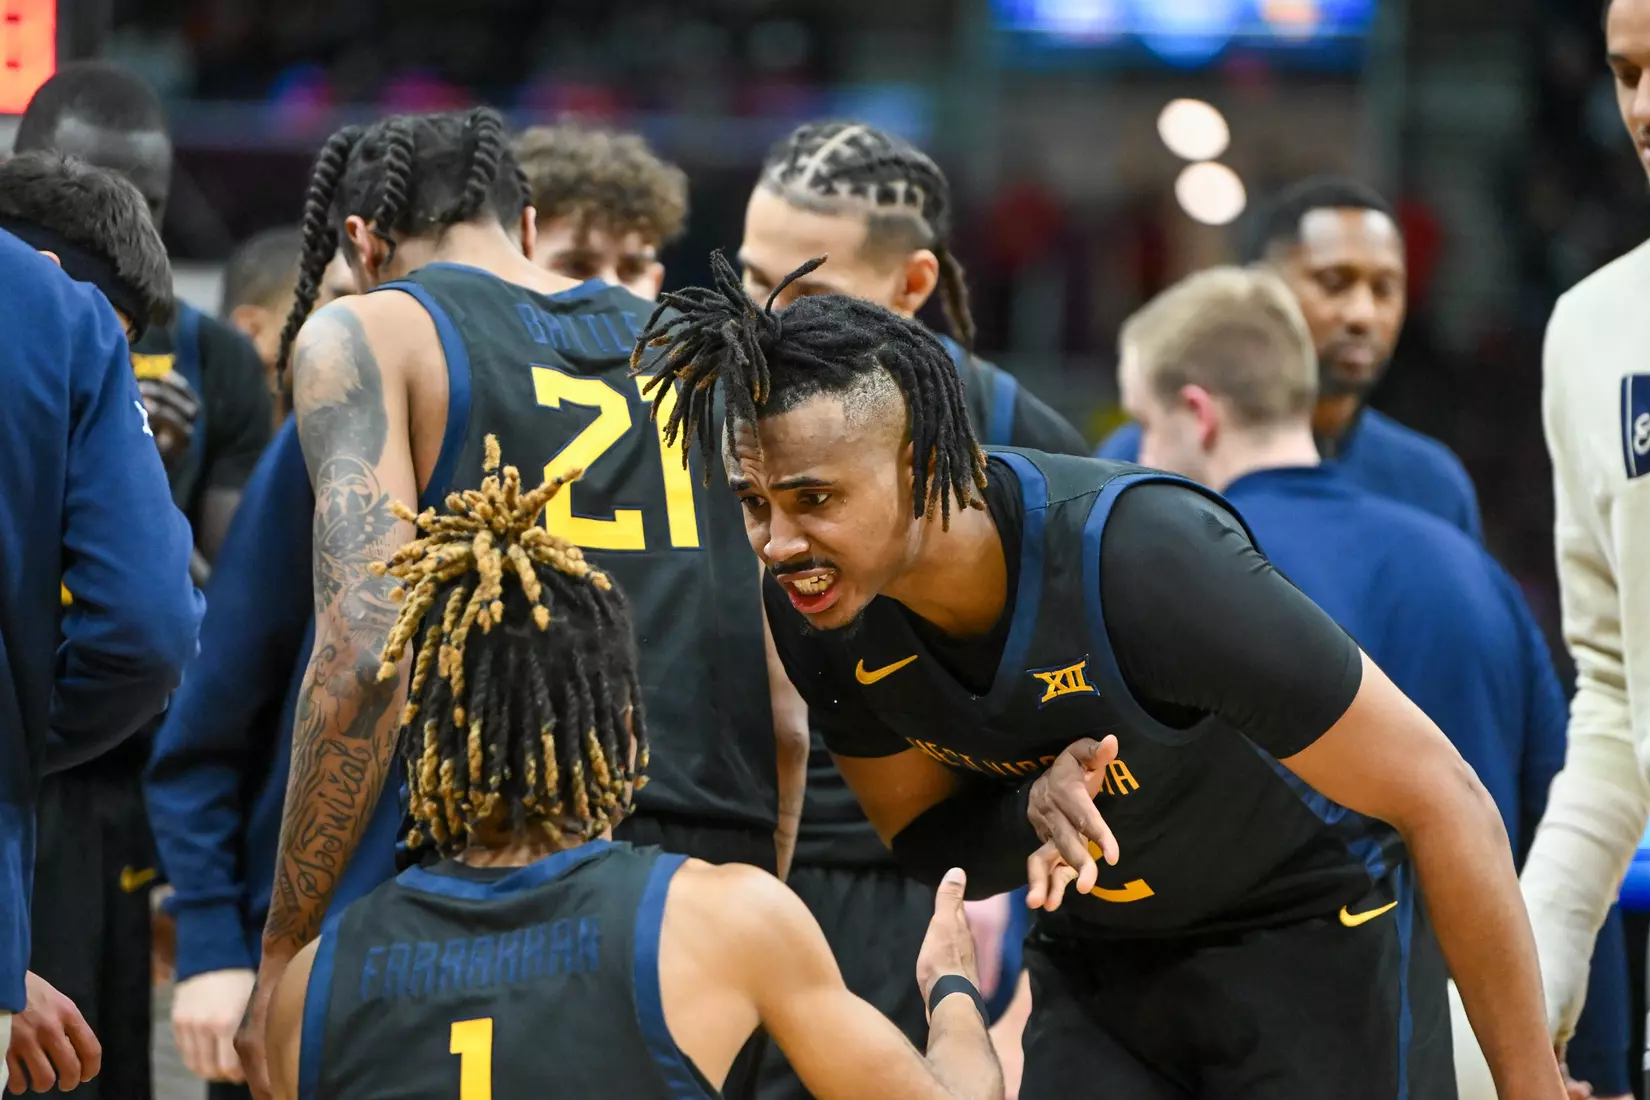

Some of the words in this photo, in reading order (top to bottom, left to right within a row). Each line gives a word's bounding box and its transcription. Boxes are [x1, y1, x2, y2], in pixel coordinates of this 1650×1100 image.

[530, 364, 701, 551] 21
[1032, 659, 1095, 703] XII
[360, 914, 601, 1000] FARRAKHAN
[449, 1016, 493, 1100] 1
